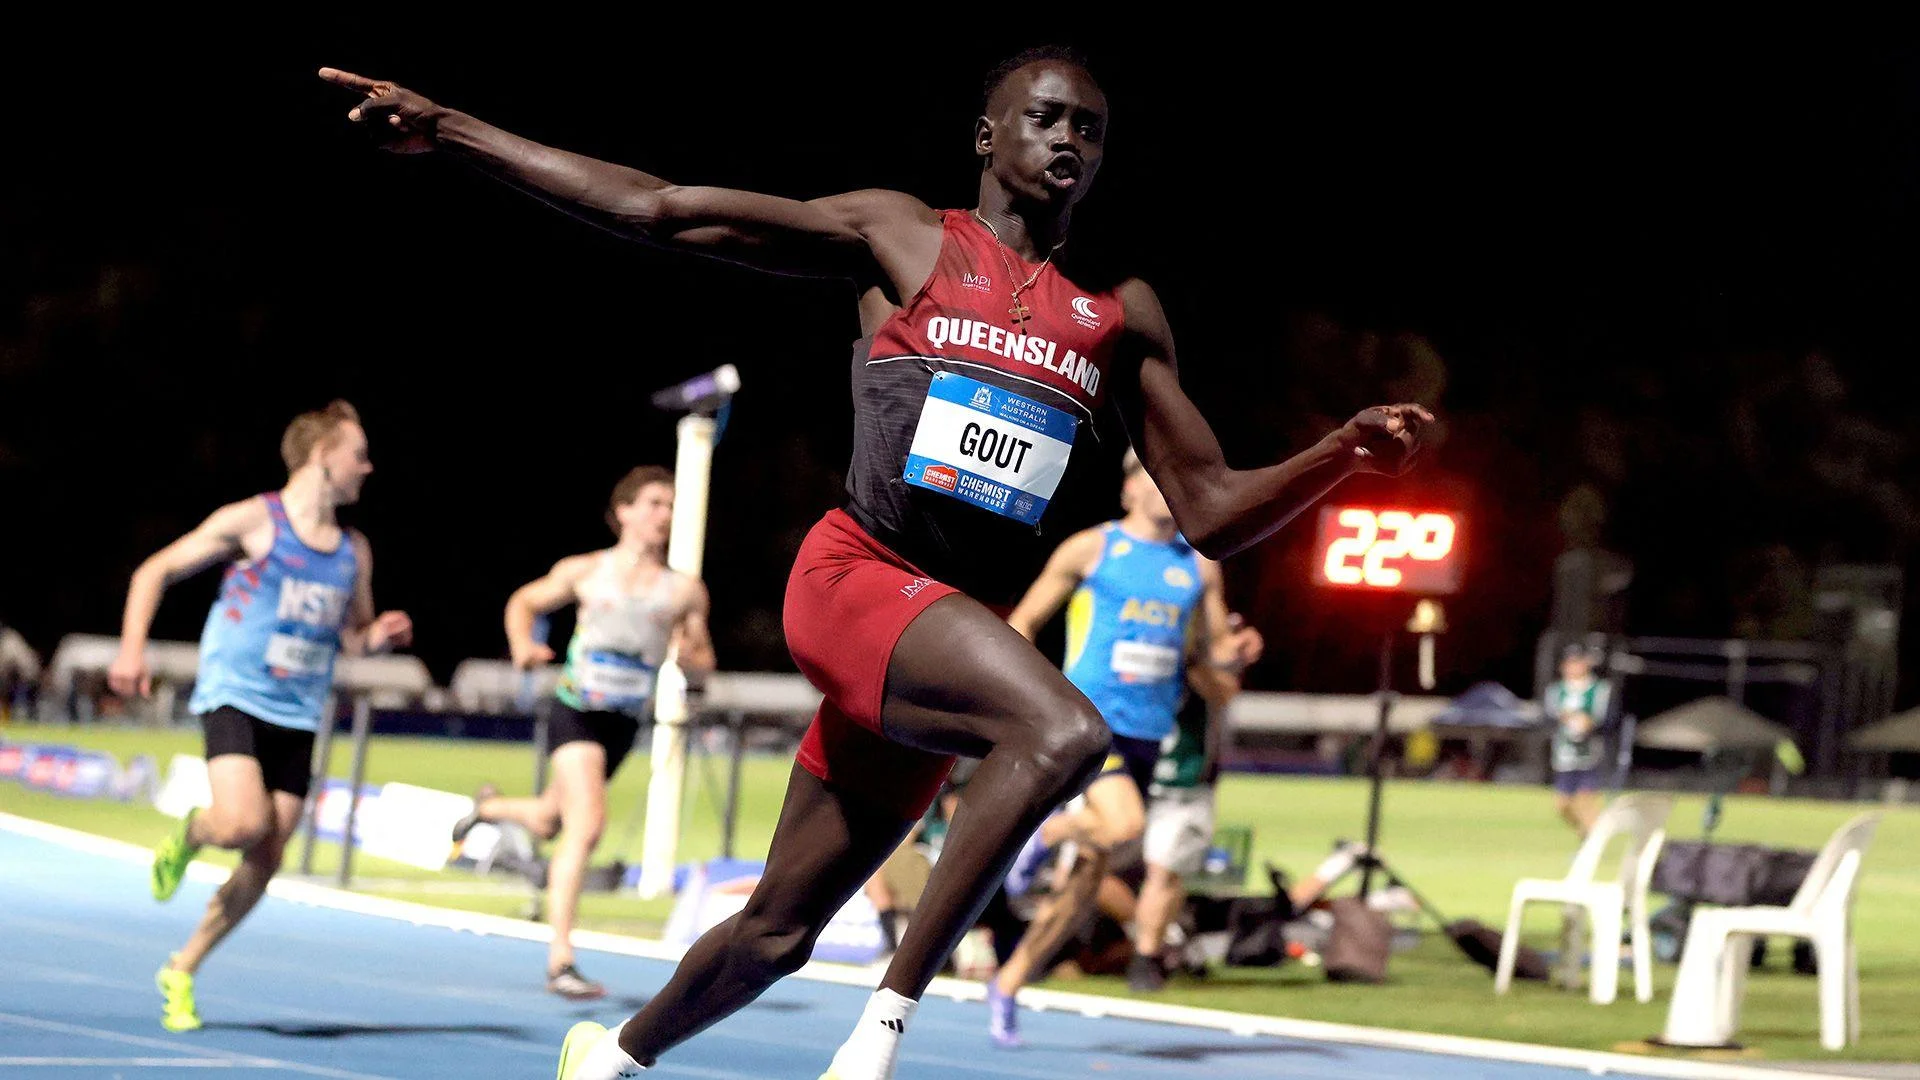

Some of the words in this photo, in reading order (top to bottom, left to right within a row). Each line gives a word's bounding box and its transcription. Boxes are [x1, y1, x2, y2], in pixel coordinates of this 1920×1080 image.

[963, 272, 991, 287] IMPI
[926, 316, 1101, 397] QUEENSLAND
[1001, 404, 1047, 425] AUSTRALIA
[1007, 396, 1048, 416] WESTERN
[959, 421, 1033, 474] GOUT
[926, 469, 956, 484] CHEMIST
[957, 487, 1006, 510] WAREHOUSE
[960, 474, 1012, 503] CHEMIST
